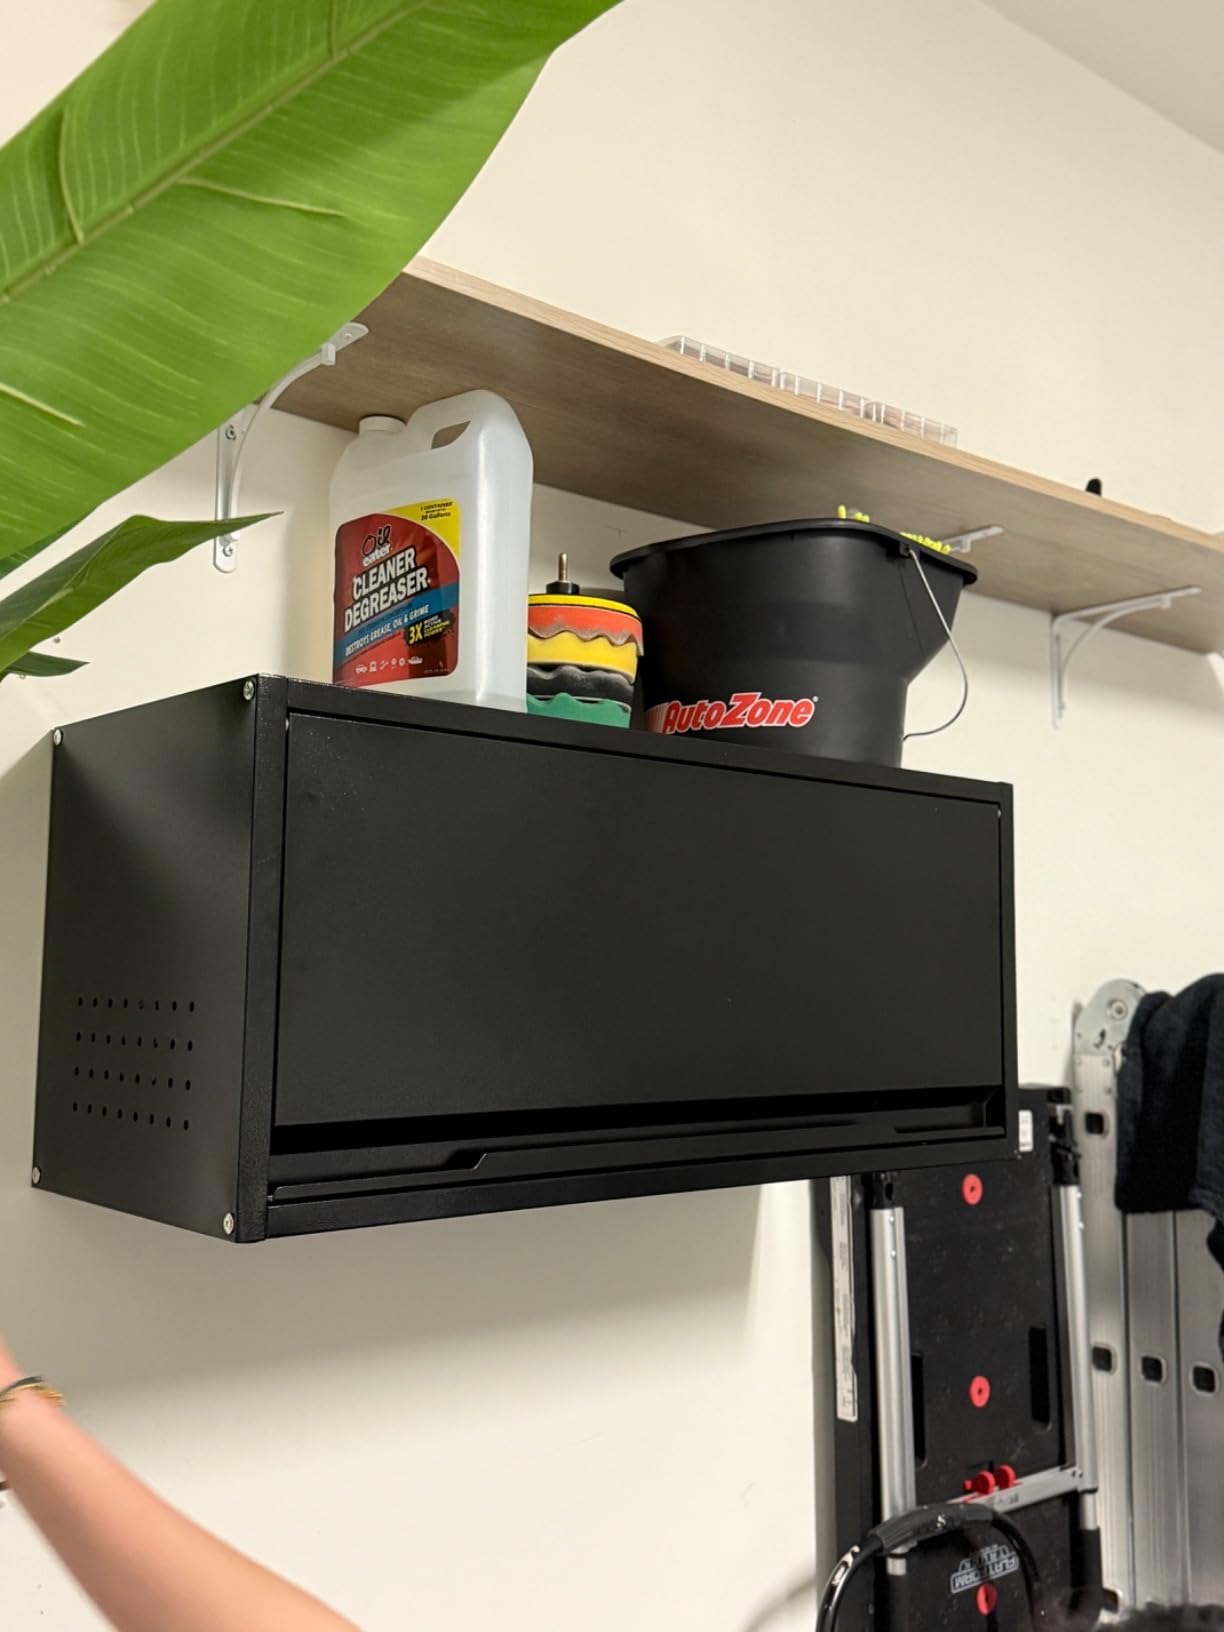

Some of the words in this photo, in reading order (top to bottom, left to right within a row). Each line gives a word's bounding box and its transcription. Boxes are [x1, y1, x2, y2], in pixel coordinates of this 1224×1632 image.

[361, 525, 391, 557] Oil
[353, 547, 416, 600] CLEANER
[344, 566, 428, 632] DEGREASER
[403, 613, 408, 623] &
[409, 604, 429, 620] GRIME
[409, 622, 423, 644] 3X
[661, 692, 815, 735] AutoZone
[954, 1556, 1016, 1589] PLATORM
